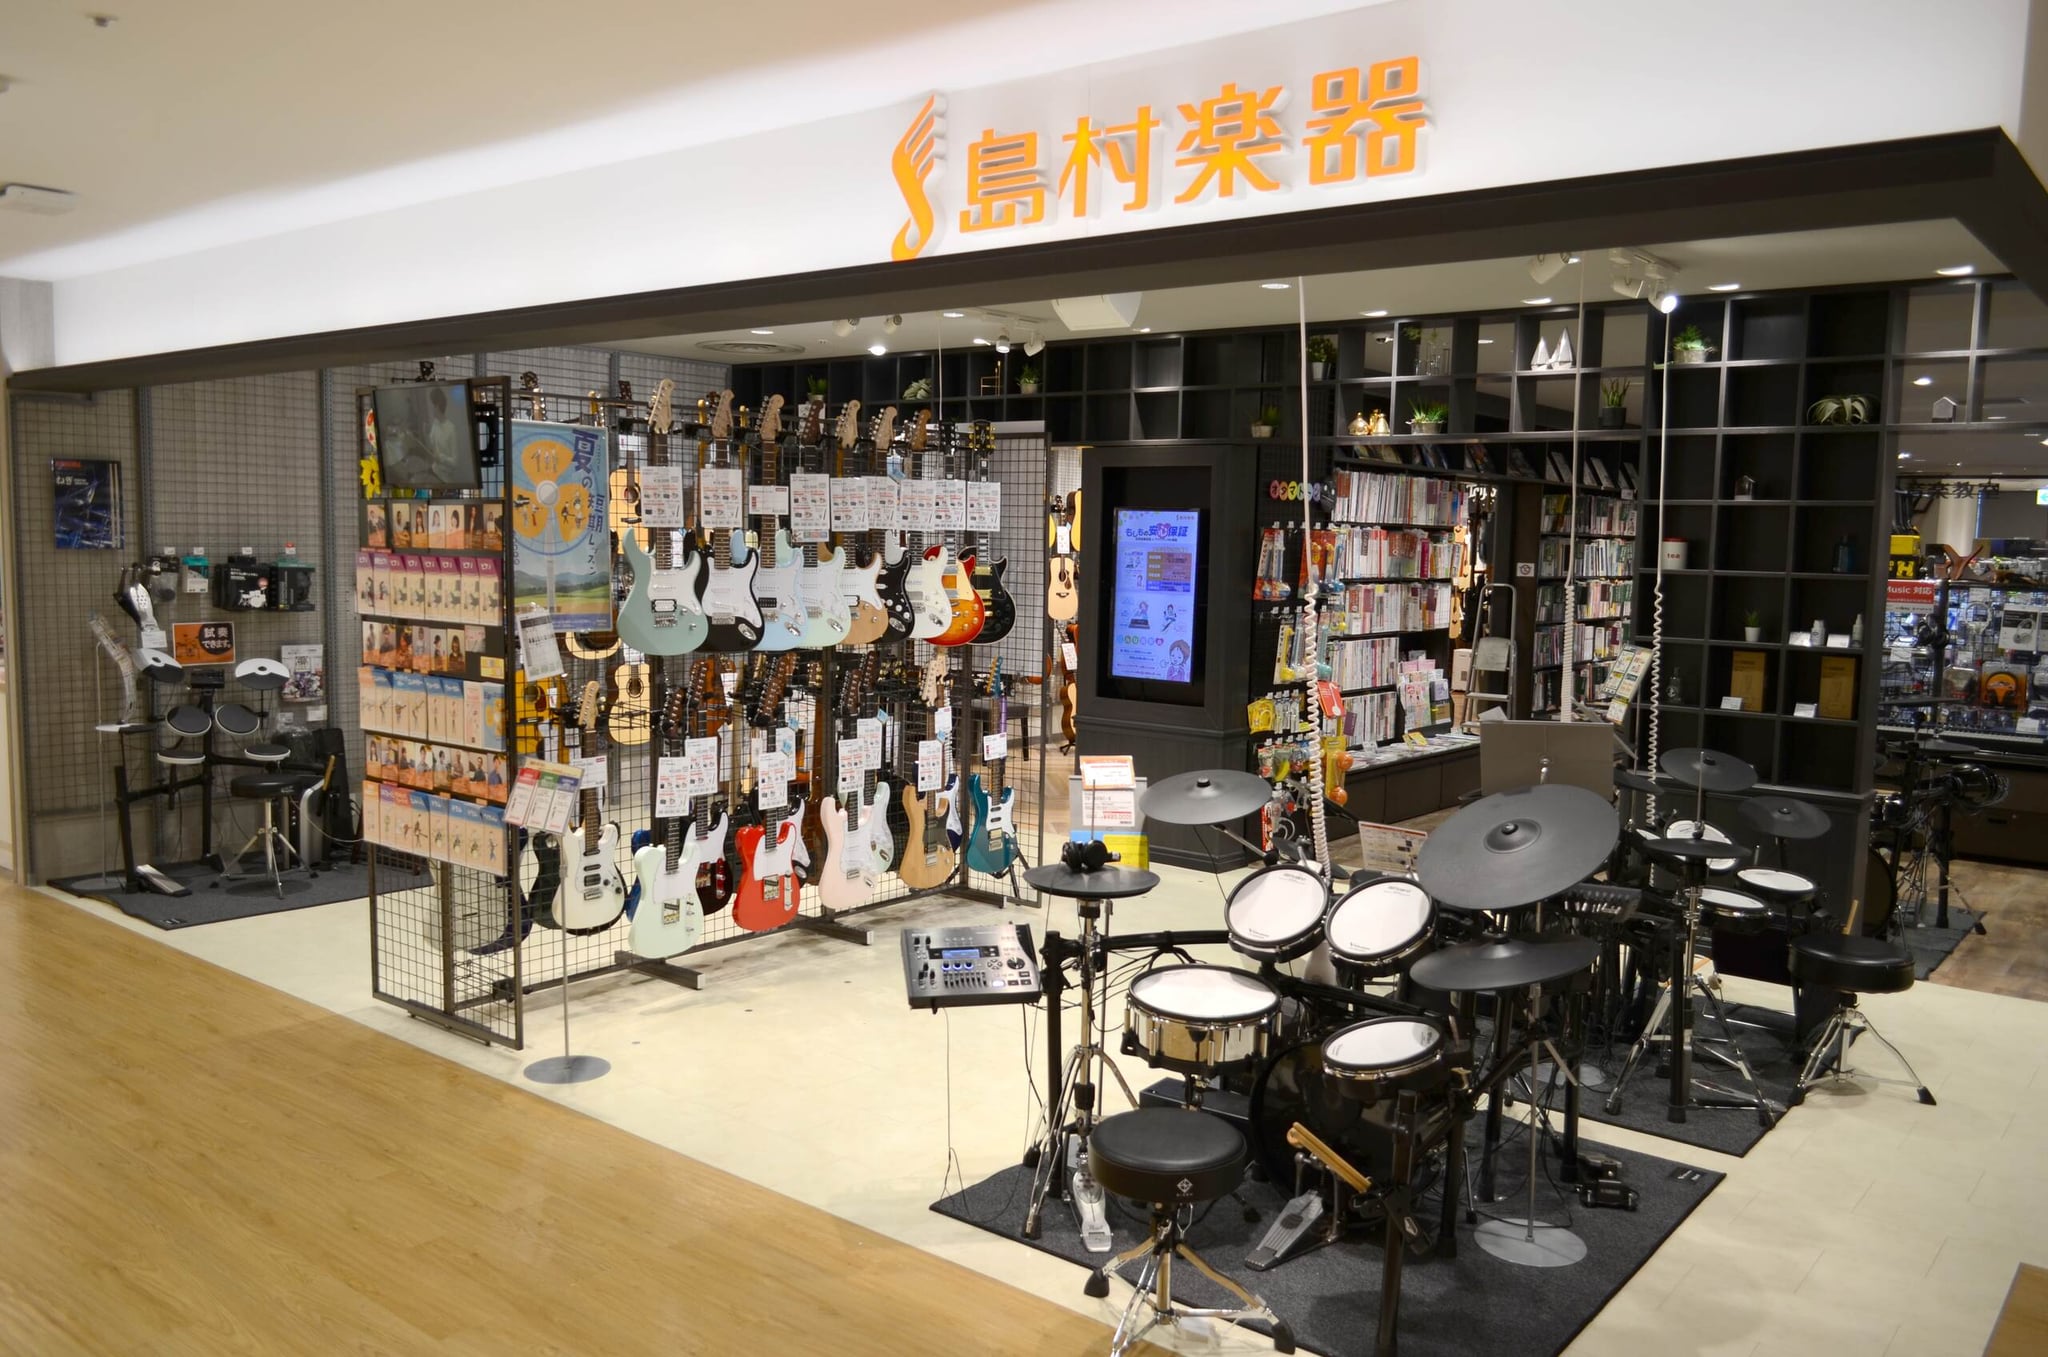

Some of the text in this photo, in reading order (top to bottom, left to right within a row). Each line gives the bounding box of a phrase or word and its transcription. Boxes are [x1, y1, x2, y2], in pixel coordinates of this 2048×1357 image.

[959, 55, 1427, 234] 島村楽器
[1667, 552, 1681, 560] tea
[203, 627, 230, 639] 試奏
